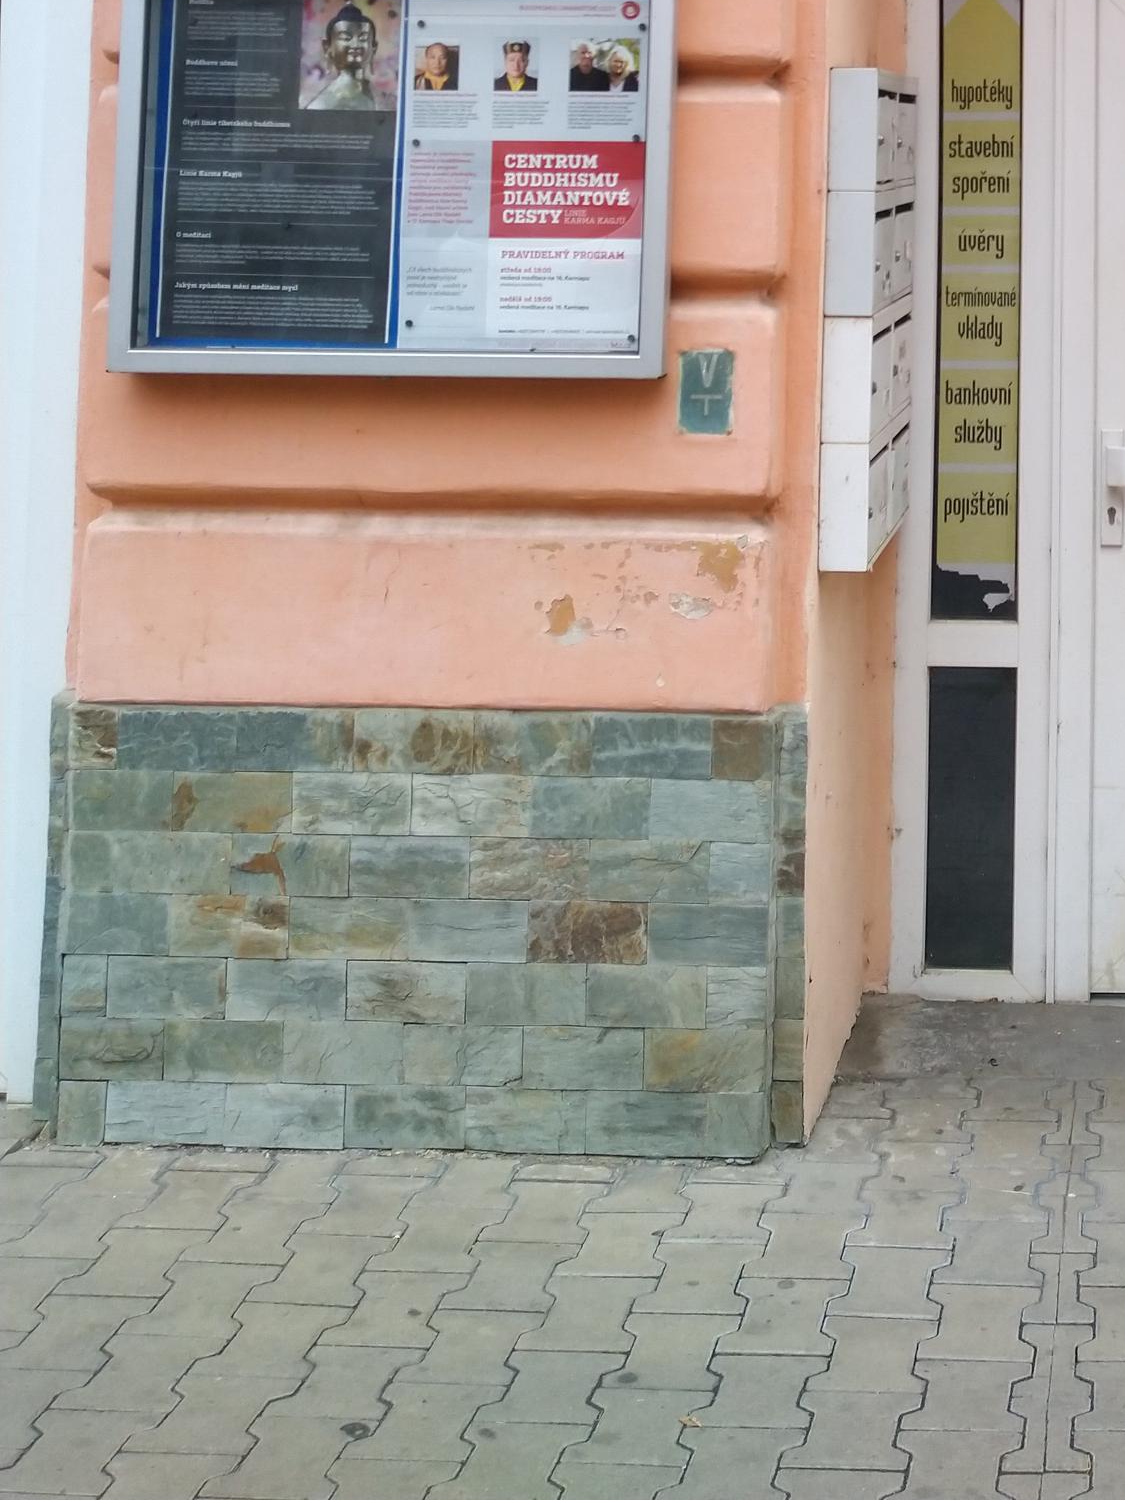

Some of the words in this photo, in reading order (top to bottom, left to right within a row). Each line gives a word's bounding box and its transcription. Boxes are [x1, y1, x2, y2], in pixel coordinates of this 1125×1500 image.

[951, 78, 1013, 110] hypotéky
[949, 133, 1014, 159] stavební
[503, 154, 599, 169] CENTRUM
[503, 172, 619, 187] BUDDHISMU
[952, 170, 1011, 201] spoření
[503, 188, 630, 206] DIAMANTOVÉ
[502, 209, 563, 225] CESTY
[501, 249, 569, 259] PRAVIDELNÝ
[573, 251, 625, 260] PROGRAM
[957, 228, 1004, 260] úvěry
[944, 285, 1016, 308] termínované
[957, 314, 1003, 347] vklady
[945, 379, 1012, 406] bankovní
[954, 417, 1002, 451] služby
[943, 490, 1010, 523] pojištění
